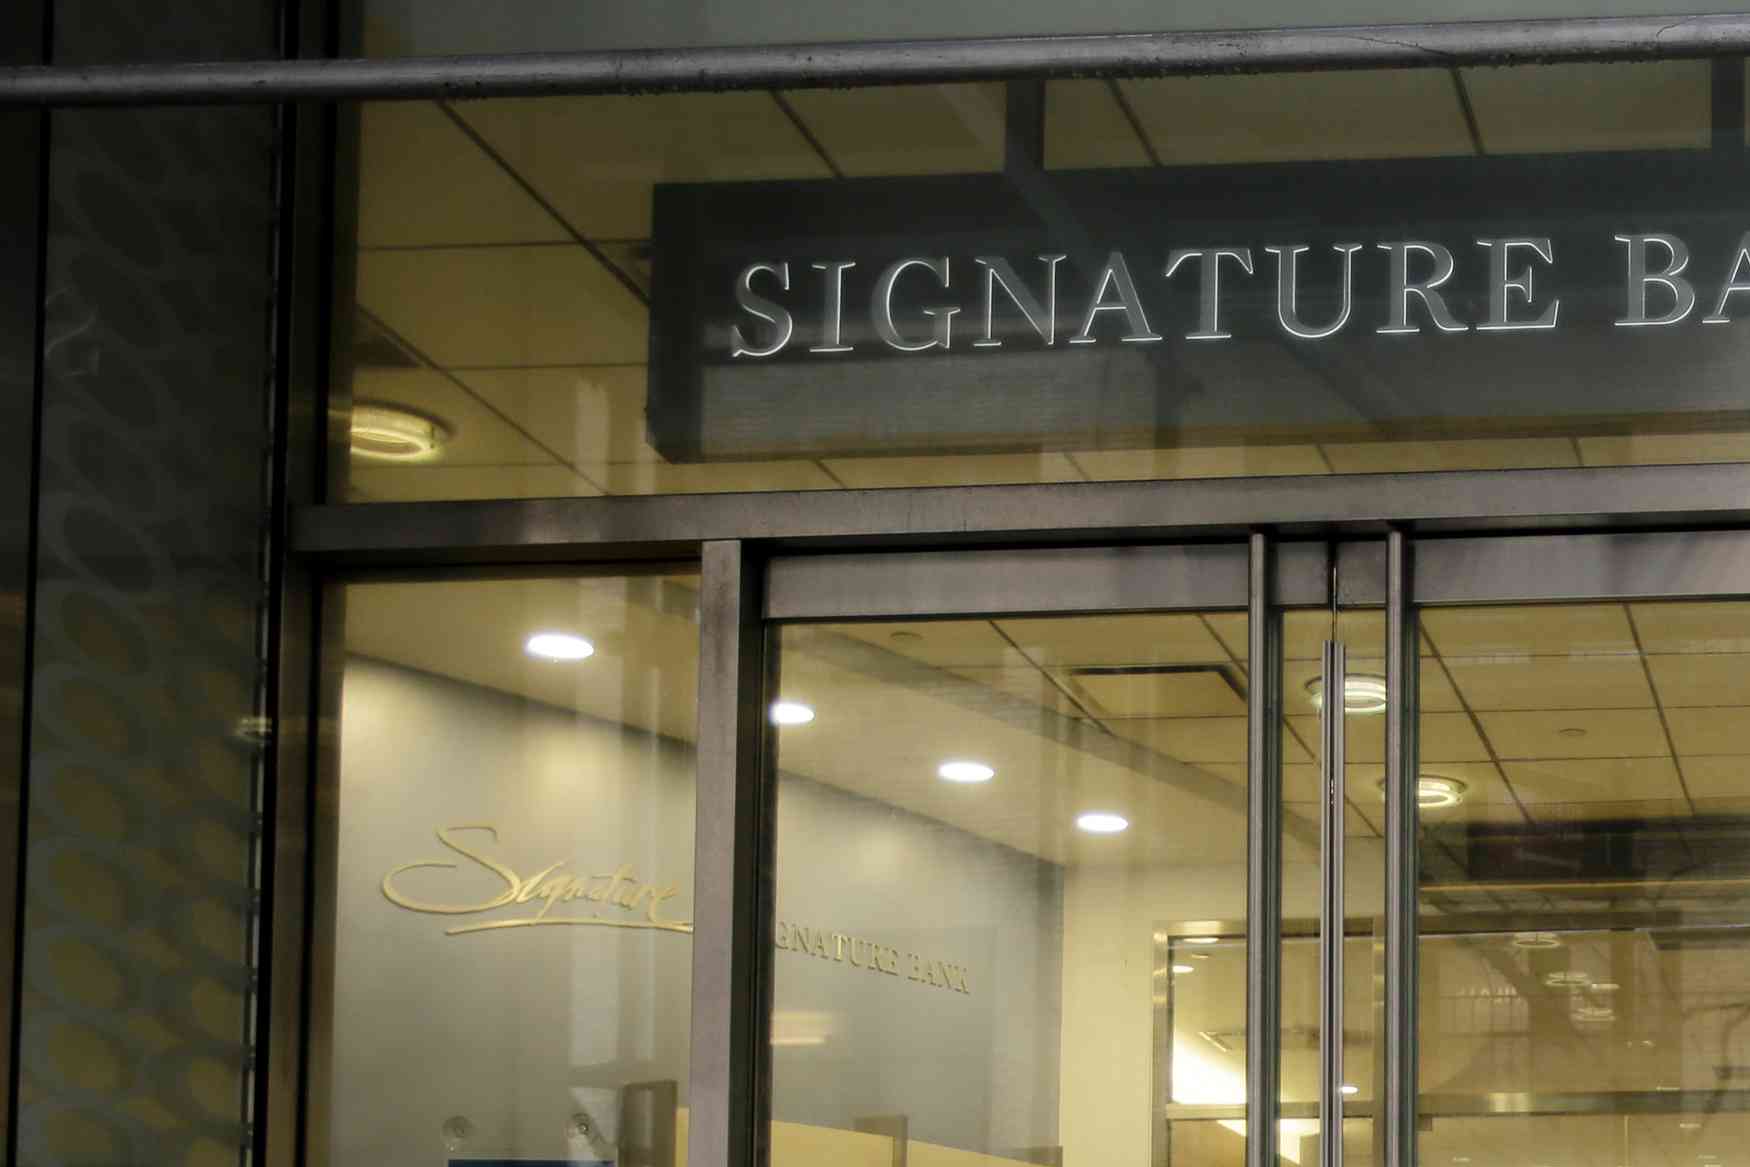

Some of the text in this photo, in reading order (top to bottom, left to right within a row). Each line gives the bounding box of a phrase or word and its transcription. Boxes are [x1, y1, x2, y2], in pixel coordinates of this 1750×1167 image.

[731, 238, 1560, 357] SIGNATURE
[381, 826, 693, 935] Signature
[776, 920, 899, 976] GNATURE
